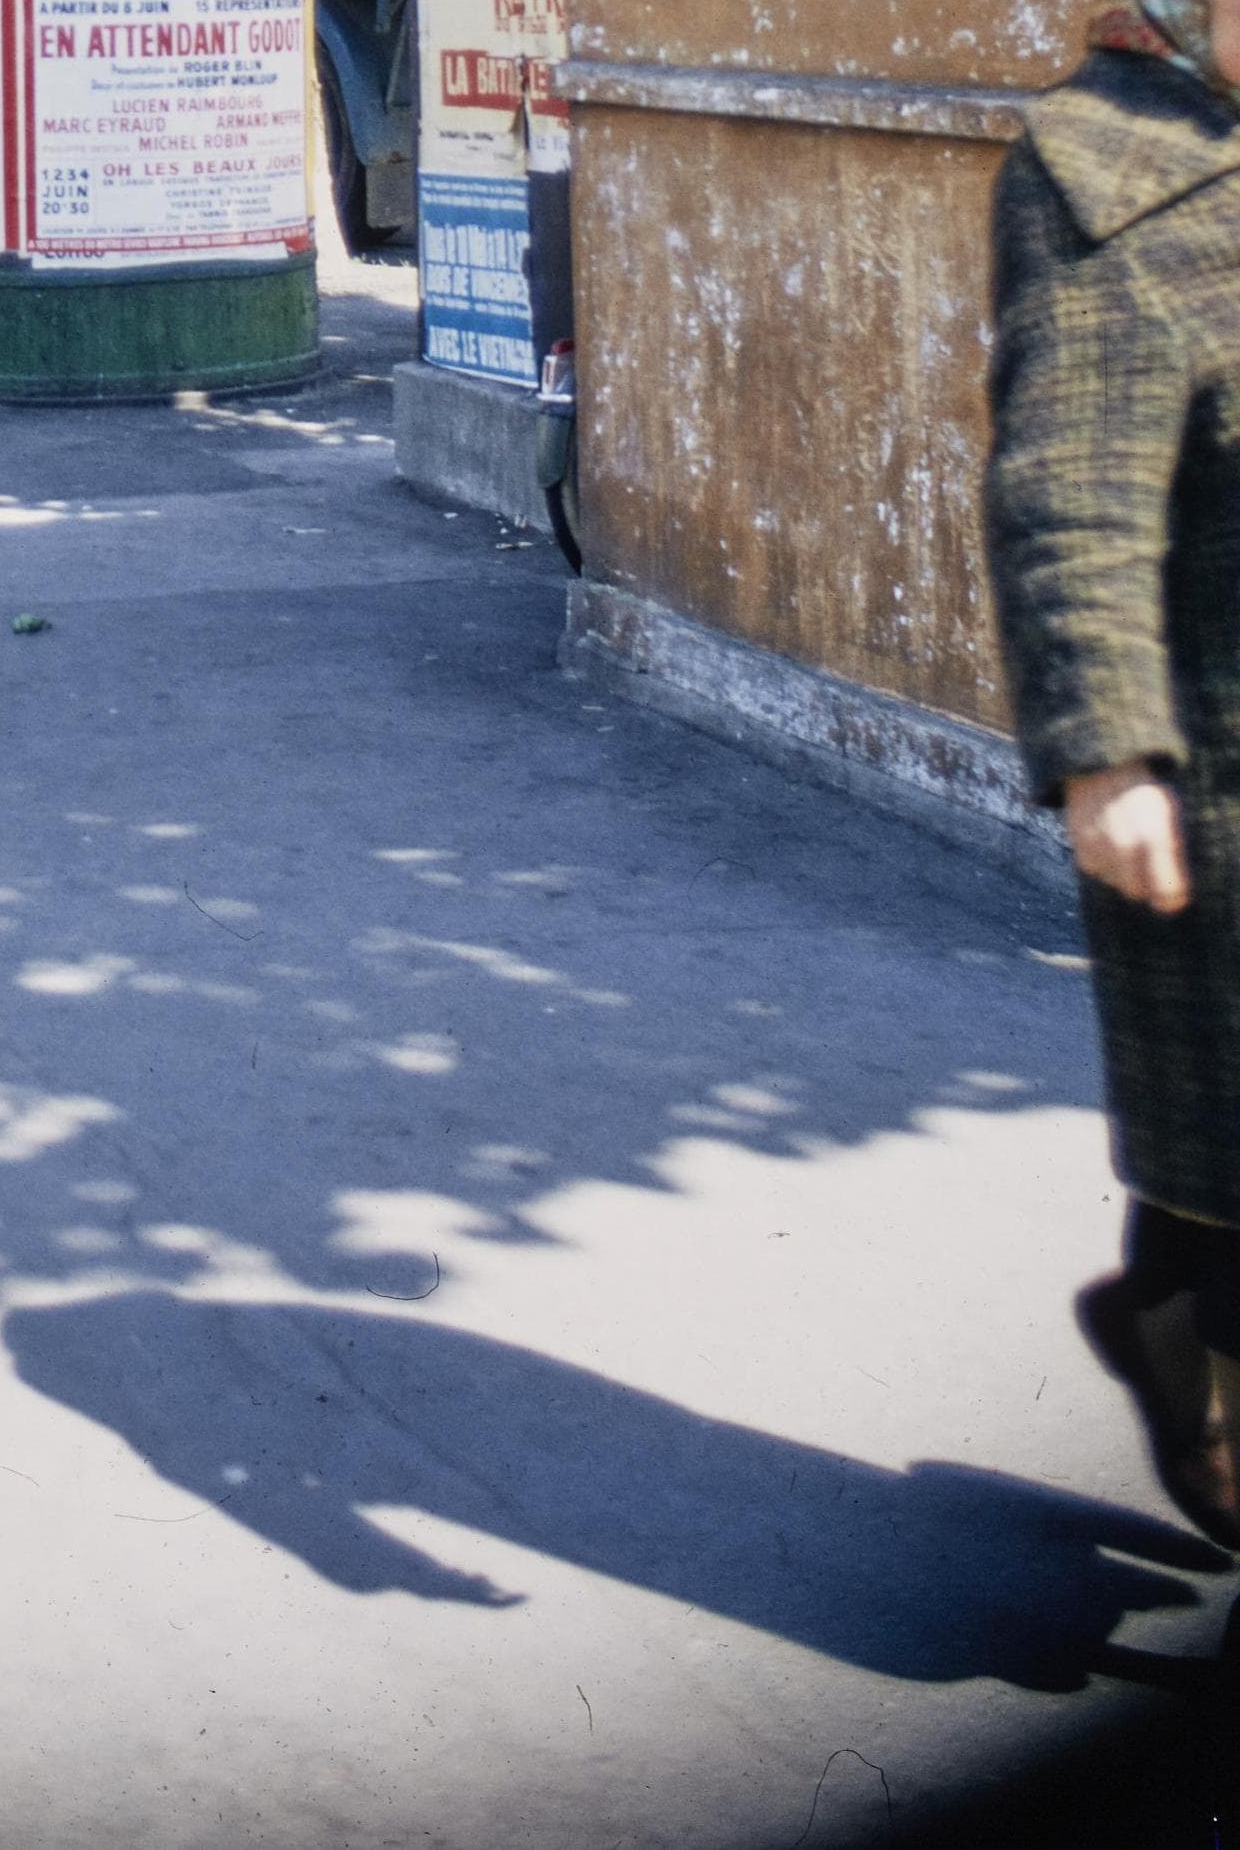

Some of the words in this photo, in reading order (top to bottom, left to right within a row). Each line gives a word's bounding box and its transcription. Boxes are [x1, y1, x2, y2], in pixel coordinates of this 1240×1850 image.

[52, 1, 97, 14] PARTIR
[138, 0, 169, 13] JUIN
[40, 25, 75, 58] EN
[87, 21, 240, 58] ATTENDANT
[249, 18, 301, 54] GODOT
[184, 61, 230, 73] ROGER
[235, 60, 262, 71] BLIN
[444, 55, 469, 96] LA
[177, 75, 226, 88] HUBERT
[112, 99, 169, 114] LUCIEN
[177, 95, 264, 112] RAIMBOURG
[43, 119, 91, 134] MARC
[97, 118, 166, 133] EYRAUD
[216, 113, 268, 130] ARMAND
[139, 136, 196, 151] MICHEL
[204, 134, 248, 149] ROBIN
[103, 163, 130, 177] OH
[144, 163, 179, 176] LES
[193, 158, 256, 174] BEAUX
[42, 185, 89, 198] JUIN
